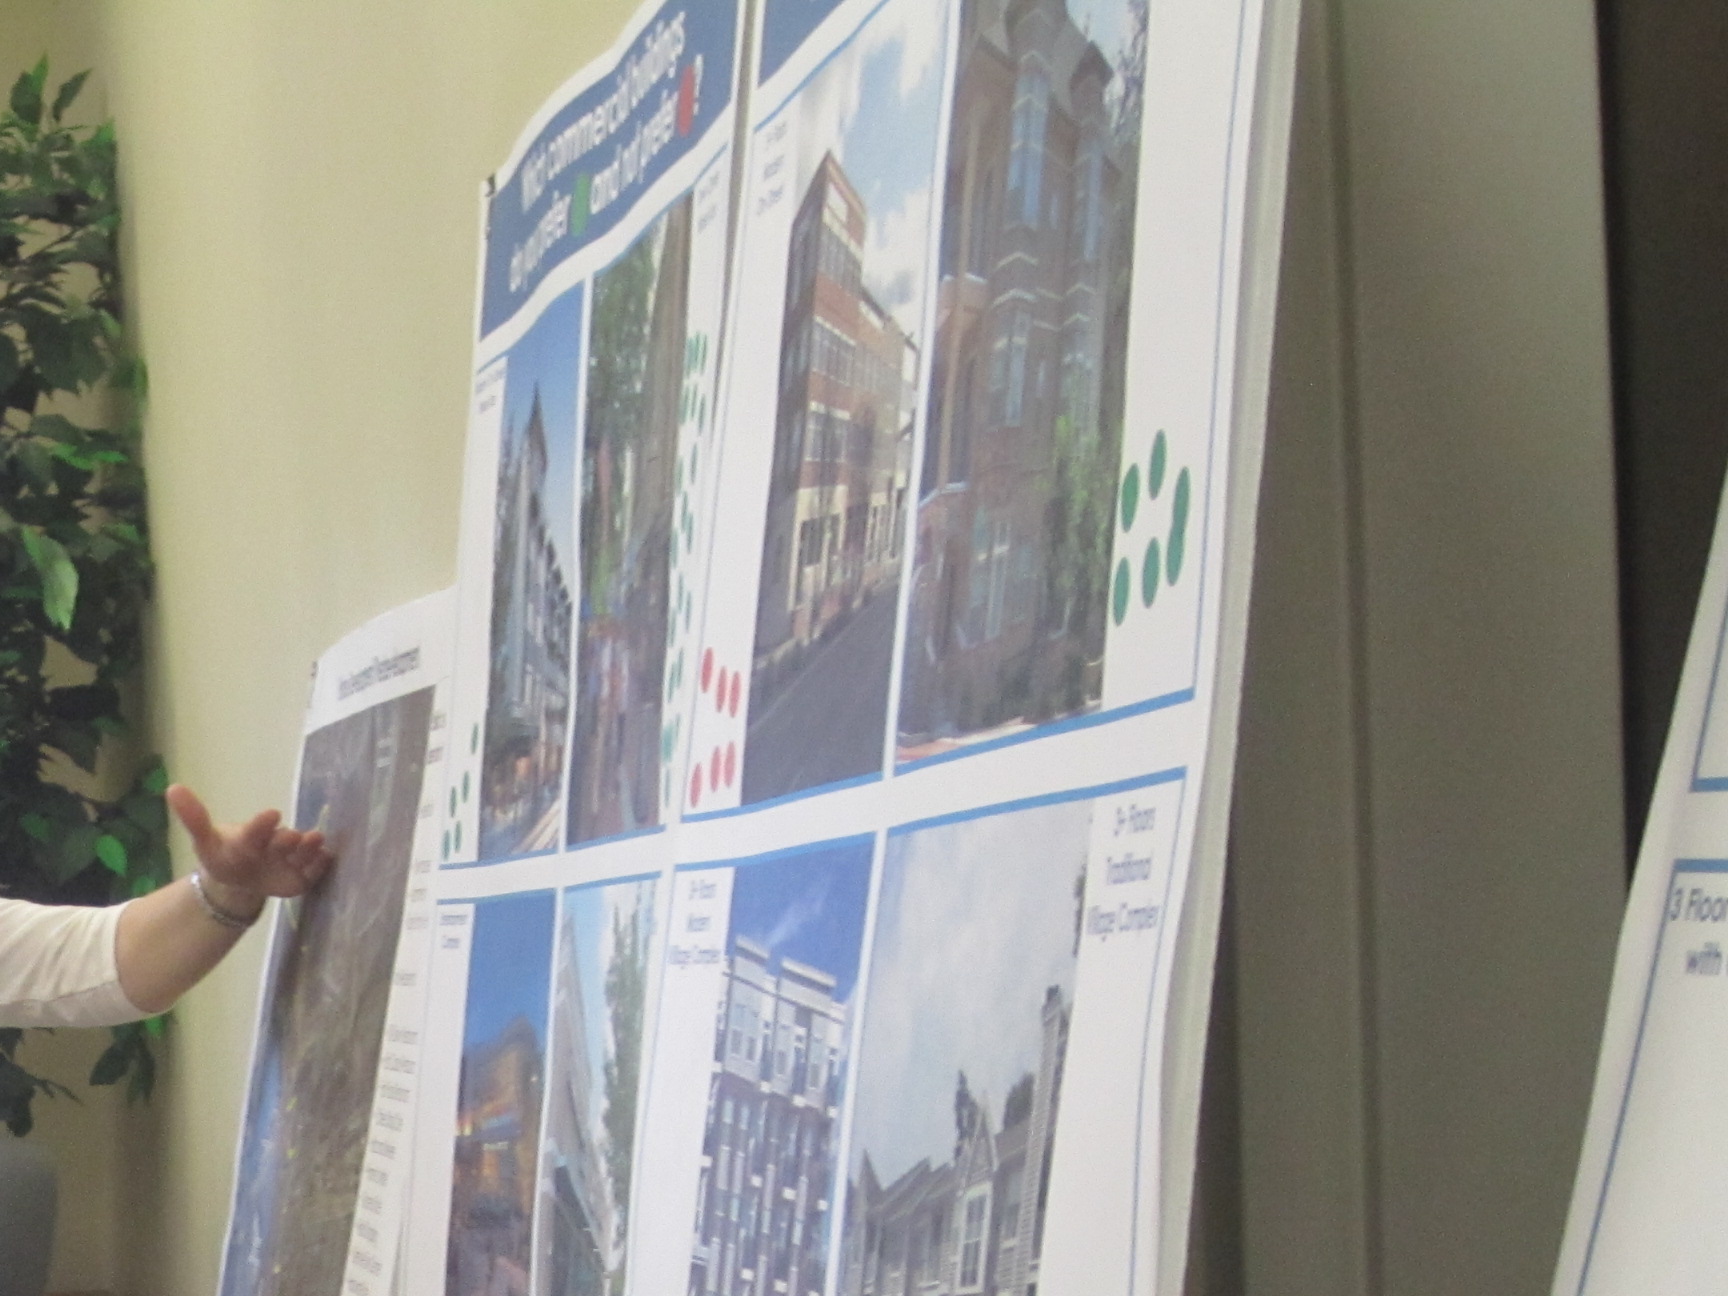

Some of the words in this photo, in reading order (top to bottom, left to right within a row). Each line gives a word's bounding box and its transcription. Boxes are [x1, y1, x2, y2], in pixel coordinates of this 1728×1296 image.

[546, 64, 633, 179] commercial
[630, 9, 687, 108] buildings
[590, 141, 620, 216] and
[1670, 887, 1683, 920] 3
